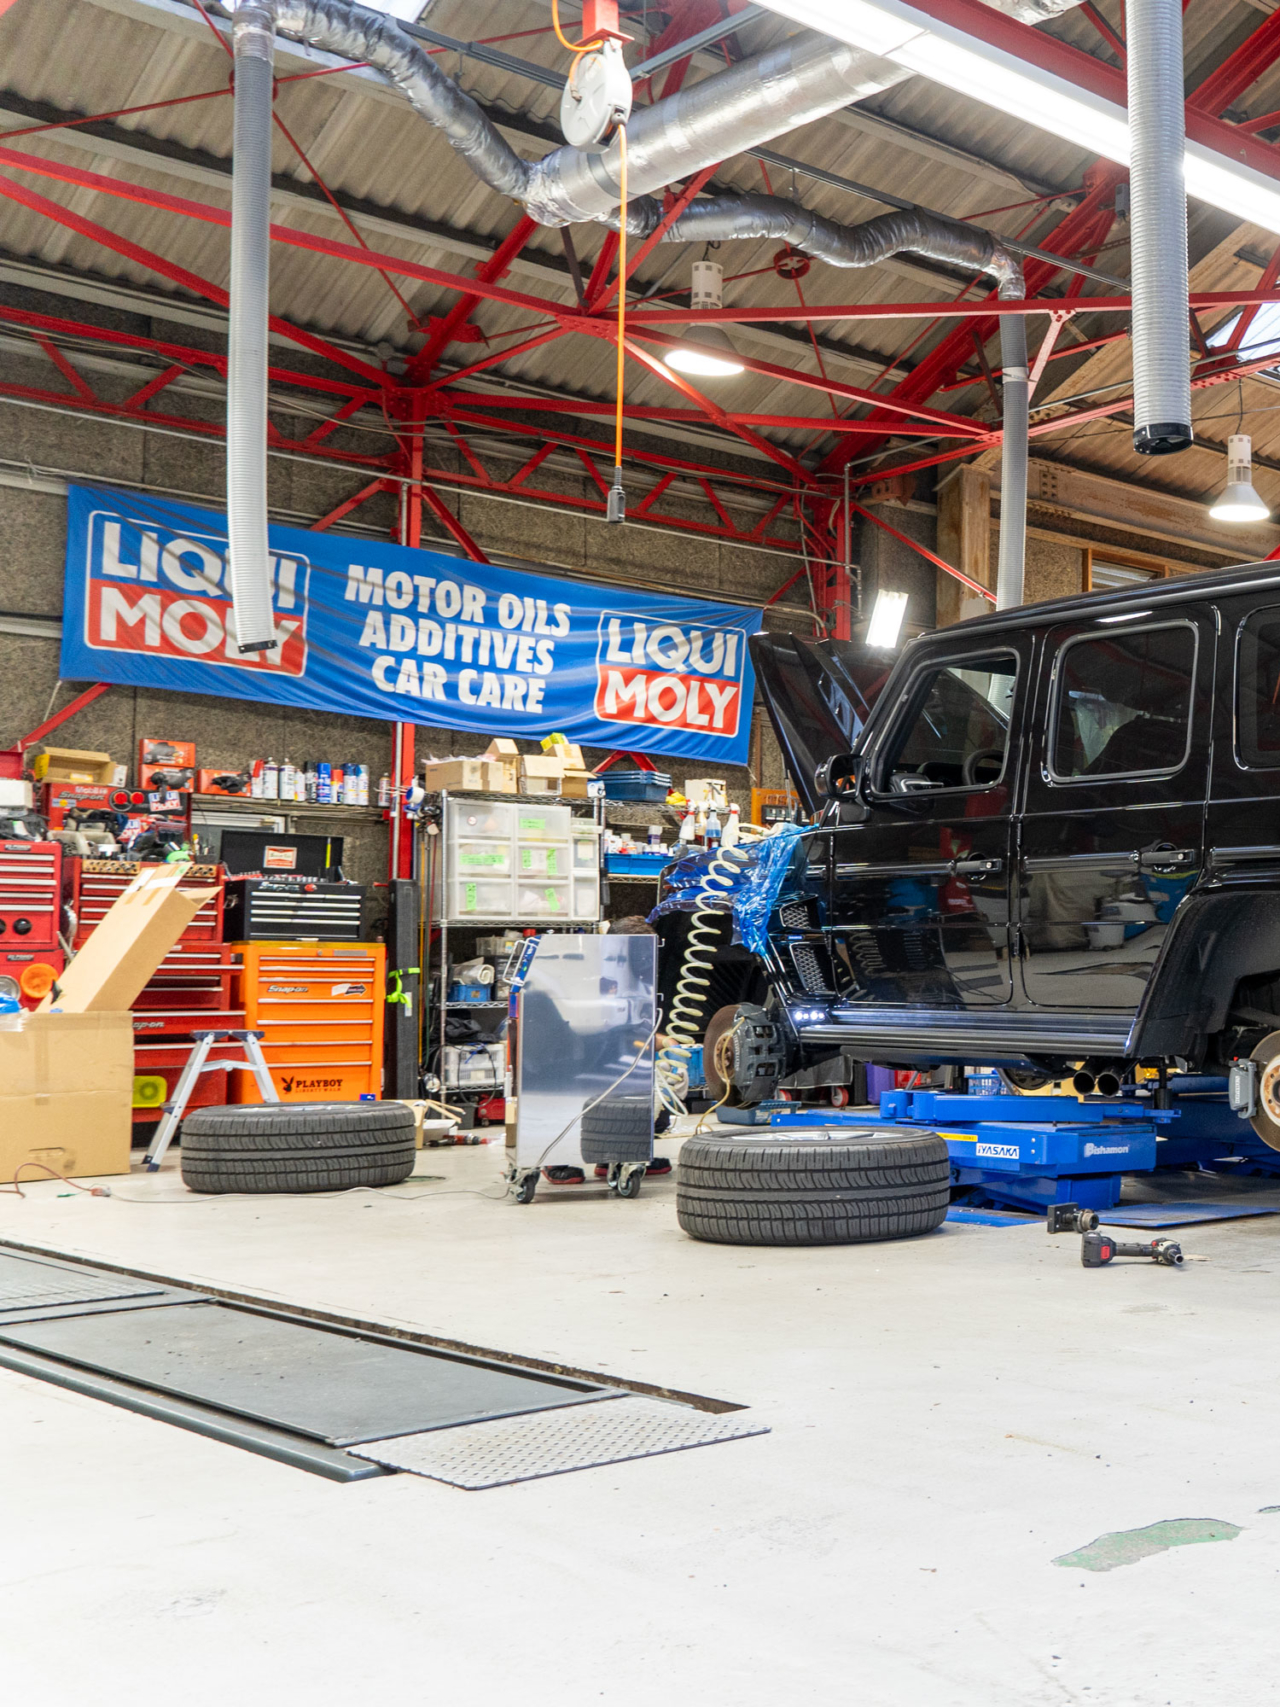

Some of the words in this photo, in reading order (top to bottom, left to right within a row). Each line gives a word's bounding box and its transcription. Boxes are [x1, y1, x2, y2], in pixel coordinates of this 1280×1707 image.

[345, 564, 487, 624] MOTOR
[498, 593, 572, 637] OILS
[358, 610, 555, 675] ADDITIVES
[606, 617, 739, 677] LIQUI
[371, 655, 448, 701] CAR
[458, 668, 546, 714] CARE
[604, 669, 739, 729] MOLY
[267, 984, 309, 994] Snap-on
[296, 1079, 343, 1088] PLAYBOY
[1084, 1142, 1129, 1158] Bishamon
